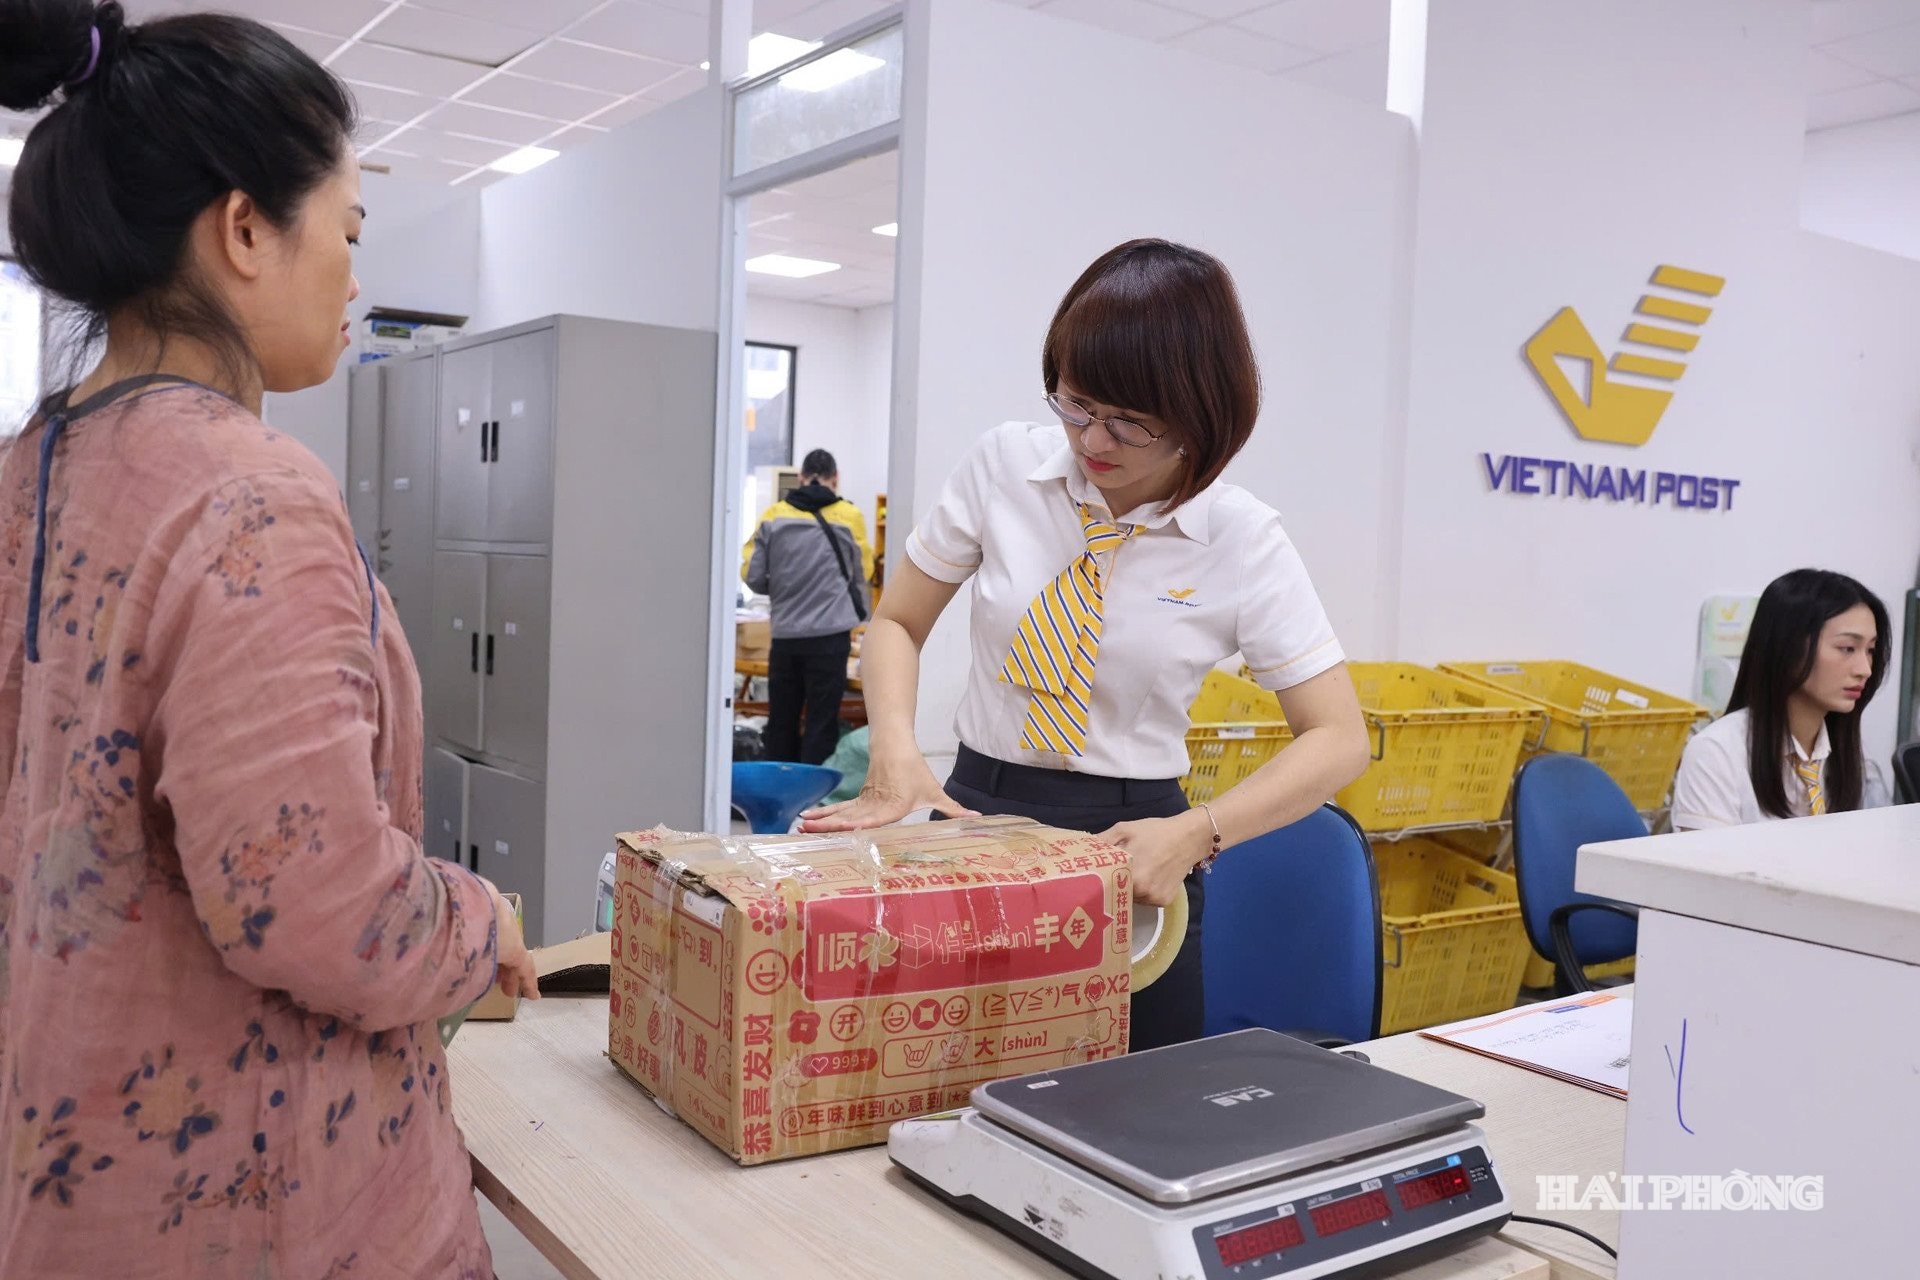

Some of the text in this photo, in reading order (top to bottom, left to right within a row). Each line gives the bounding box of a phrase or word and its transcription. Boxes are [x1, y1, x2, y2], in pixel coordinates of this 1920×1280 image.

[1483, 453, 1741, 510] VIETNAM POST
[1054, 850, 1129, 874] 过年正好
[818, 931, 858, 974] 顺
[1033, 911, 1061, 954] 丰
[1070, 918, 1086, 939] 年
[837, 1012, 858, 1034] 开
[974, 1036, 995, 1058] 大
[832, 1055, 870, 1069] 999+
[742, 1012, 774, 1157] 恭喜发财
[807, 1091, 943, 1126] 年味鲜到心意到
[1210, 1087, 1275, 1107] CAS
